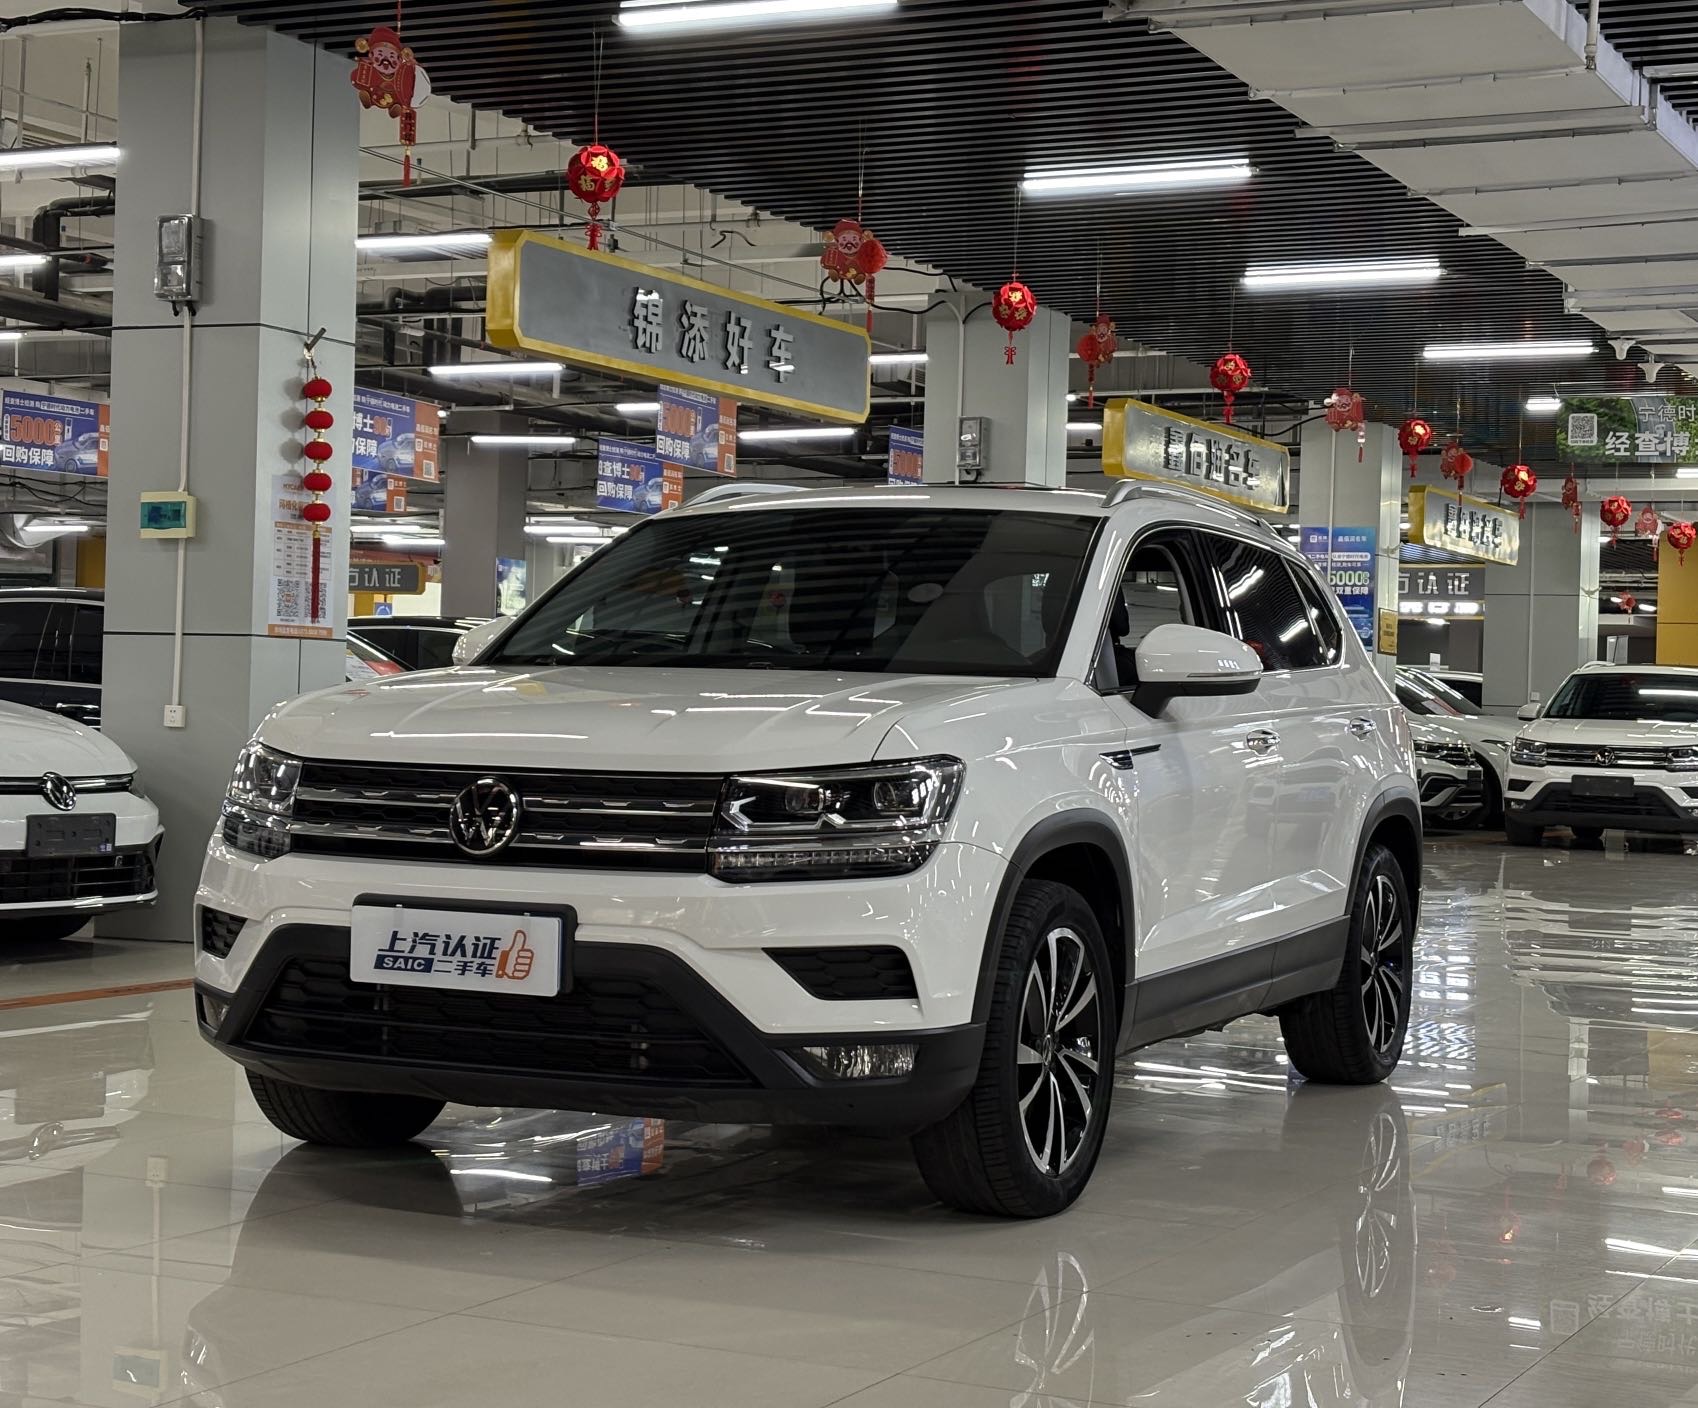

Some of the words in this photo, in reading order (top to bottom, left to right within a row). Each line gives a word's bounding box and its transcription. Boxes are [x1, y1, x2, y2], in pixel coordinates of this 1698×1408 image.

[633, 287, 795, 383] 锦添好车
[1638, 403, 1697, 422] 宁德时
[11, 414, 57, 446] 5000
[352, 437, 378, 457] 保障
[657, 435, 690, 460] 回购保障
[1605, 431, 1698, 456] 经查博
[2, 445, 54, 466] 回购保障
[596, 480, 633, 500] 回购保障
[1330, 571, 1362, 586] 5000
[1331, 586, 1369, 595] 双重保障
[378, 930, 502, 960] 上汽认证
[382, 956, 426, 970] SAIC
[433, 959, 496, 978] 二手车
